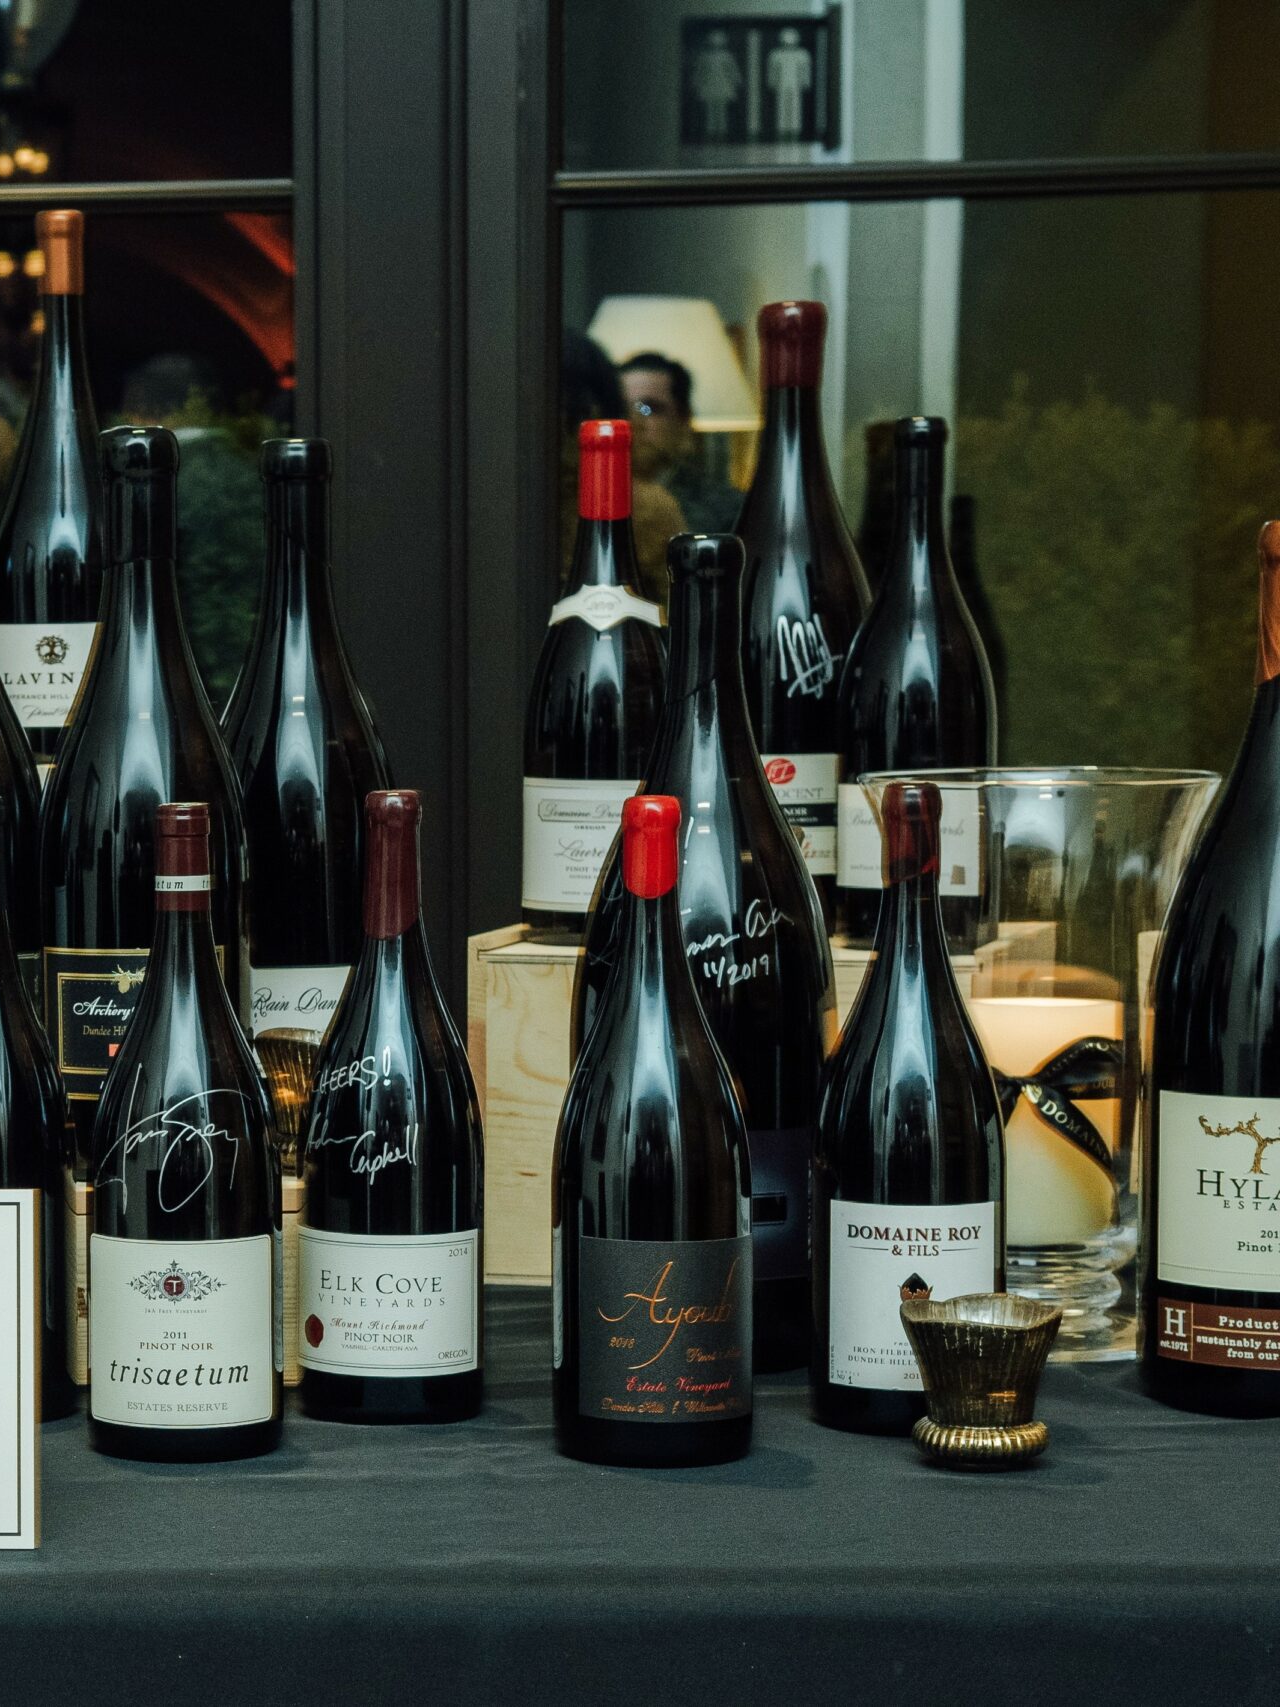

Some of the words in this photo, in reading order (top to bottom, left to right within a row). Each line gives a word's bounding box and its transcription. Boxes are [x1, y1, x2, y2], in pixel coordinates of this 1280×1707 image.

[82, 1025, 111, 1036] Dundee
[1195, 1169, 1280, 1200] HYL
[1223, 1200, 1278, 1211] ESTA
[847, 1223, 942, 1242] DOMAINE
[948, 1225, 982, 1241] ROY
[448, 1247, 469, 1257] 2014
[891, 1245, 903, 1257] &
[907, 1244, 940, 1257] FILS
[1237, 1240, 1273, 1253] Pinot
[318, 1292, 446, 1308] VINEYARDS
[329, 1317, 363, 1330] Mount
[367, 1318, 429, 1330] Richmond
[1164, 1306, 1187, 1338] H
[162, 1330, 188, 1340] 2011
[343, 1331, 380, 1343] PINOT
[382, 1333, 415, 1343] NOIR
[139, 1341, 178, 1351] PINOT
[181, 1341, 214, 1351] NOIR
[1196, 1335, 1262, 1350] sustainably
[437, 1349, 469, 1360] OREGON
[853, 1346, 877, 1354] IRON
[1226, 1347, 1255, 1359] from
[1258, 1351, 1280, 1361] our
[847, 1355, 885, 1364] DUNDEE
[109, 1357, 250, 1386] trisaetum
[625, 1375, 668, 1393] Estate
[675, 1375, 733, 1397] Vineyard
[126, 1401, 173, 1412] ESTATES
[176, 1402, 229, 1412] RESERVE
